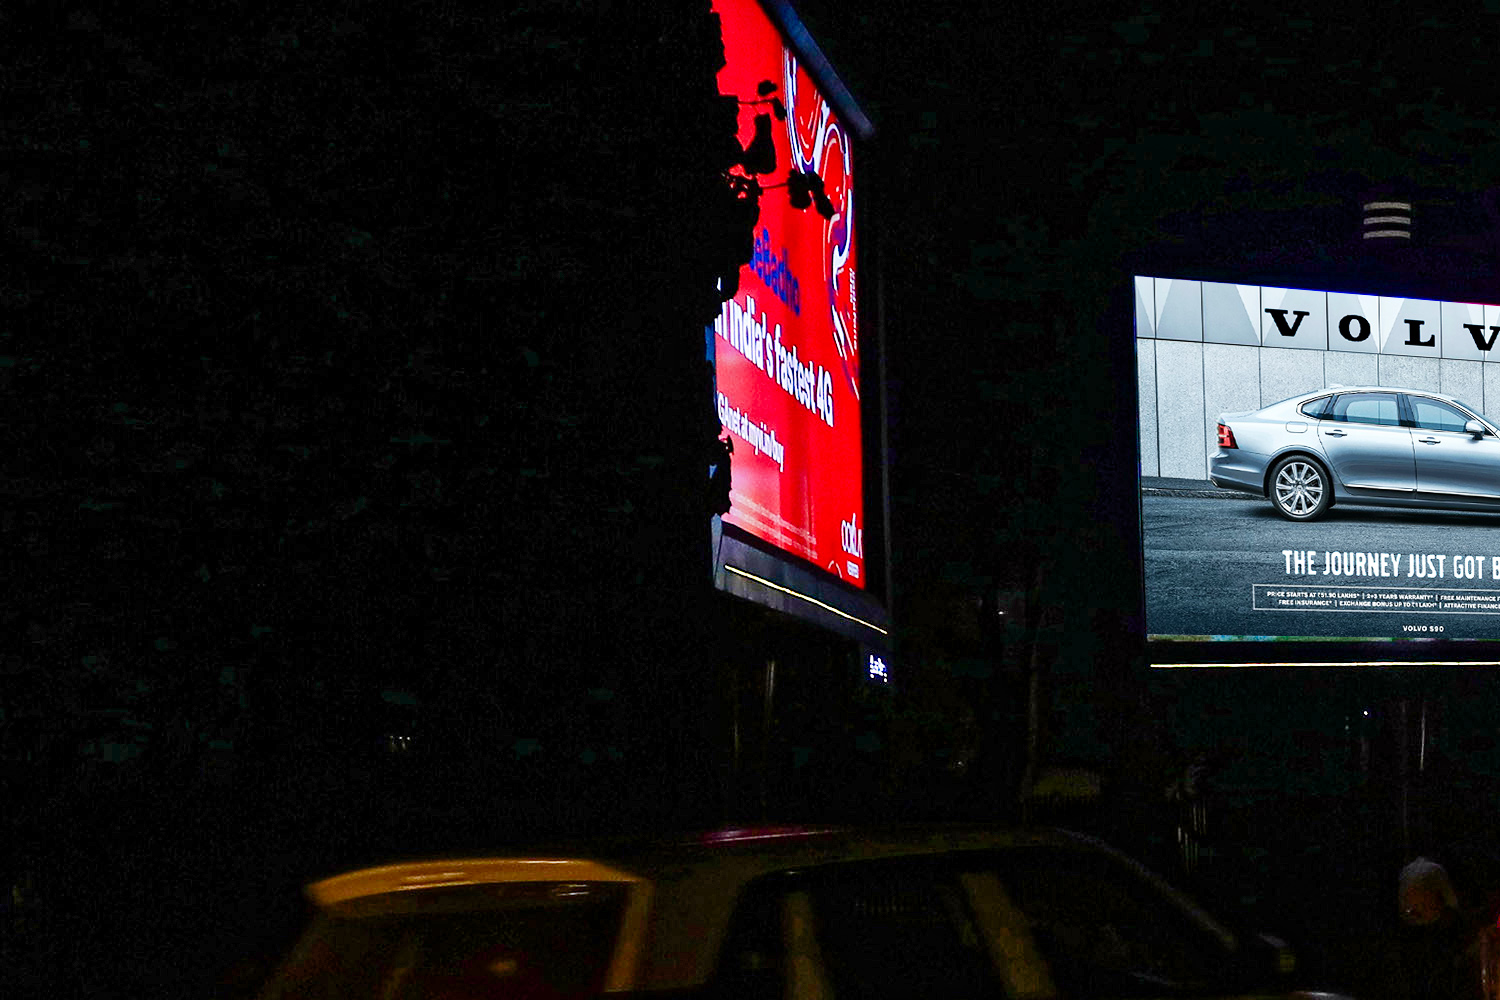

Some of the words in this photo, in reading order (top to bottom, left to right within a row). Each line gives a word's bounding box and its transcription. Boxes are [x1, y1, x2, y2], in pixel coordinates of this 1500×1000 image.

[774, 323, 816, 414] fastest
[816, 365, 834, 428] 4G
[1282, 550, 1317, 575] THE
[1323, 551, 1401, 577] JOURNEY
[1408, 554, 1446, 578] JUST
[1453, 555, 1486, 580] GOT
[1429, 625, 1445, 633] S90
